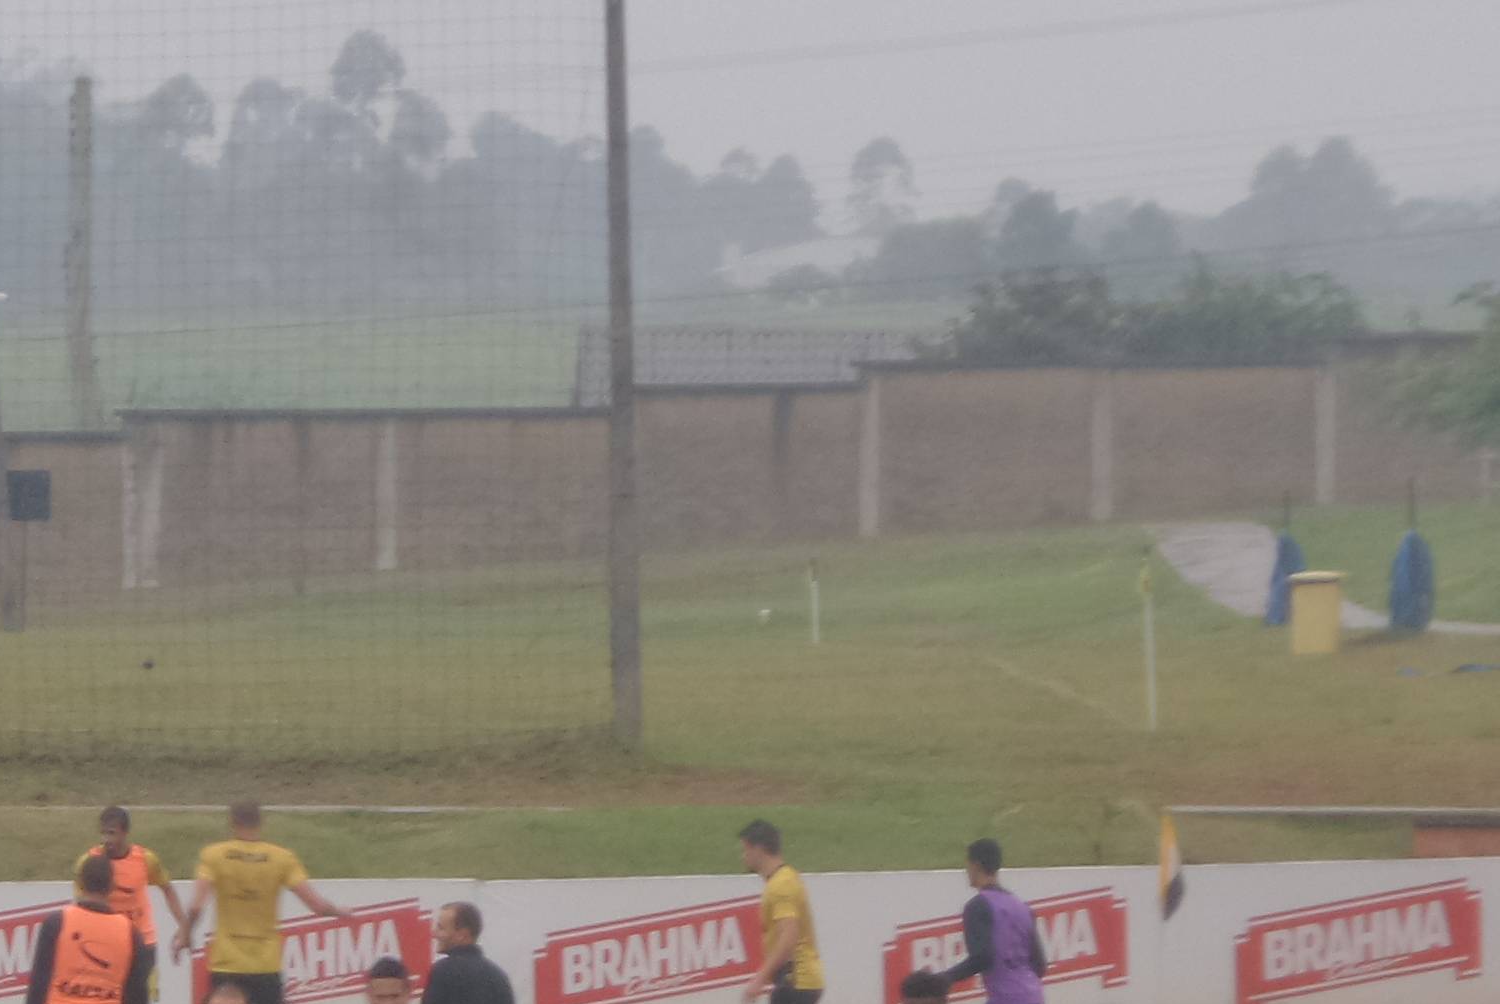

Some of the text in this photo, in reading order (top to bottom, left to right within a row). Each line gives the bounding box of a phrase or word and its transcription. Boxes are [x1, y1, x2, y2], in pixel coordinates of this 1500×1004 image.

[280, 919, 402, 984] AHMA
[562, 916, 748, 996] BRAHMA
[911, 909, 1097, 976] BRMA
[1262, 899, 1452, 981] BRAHMA
